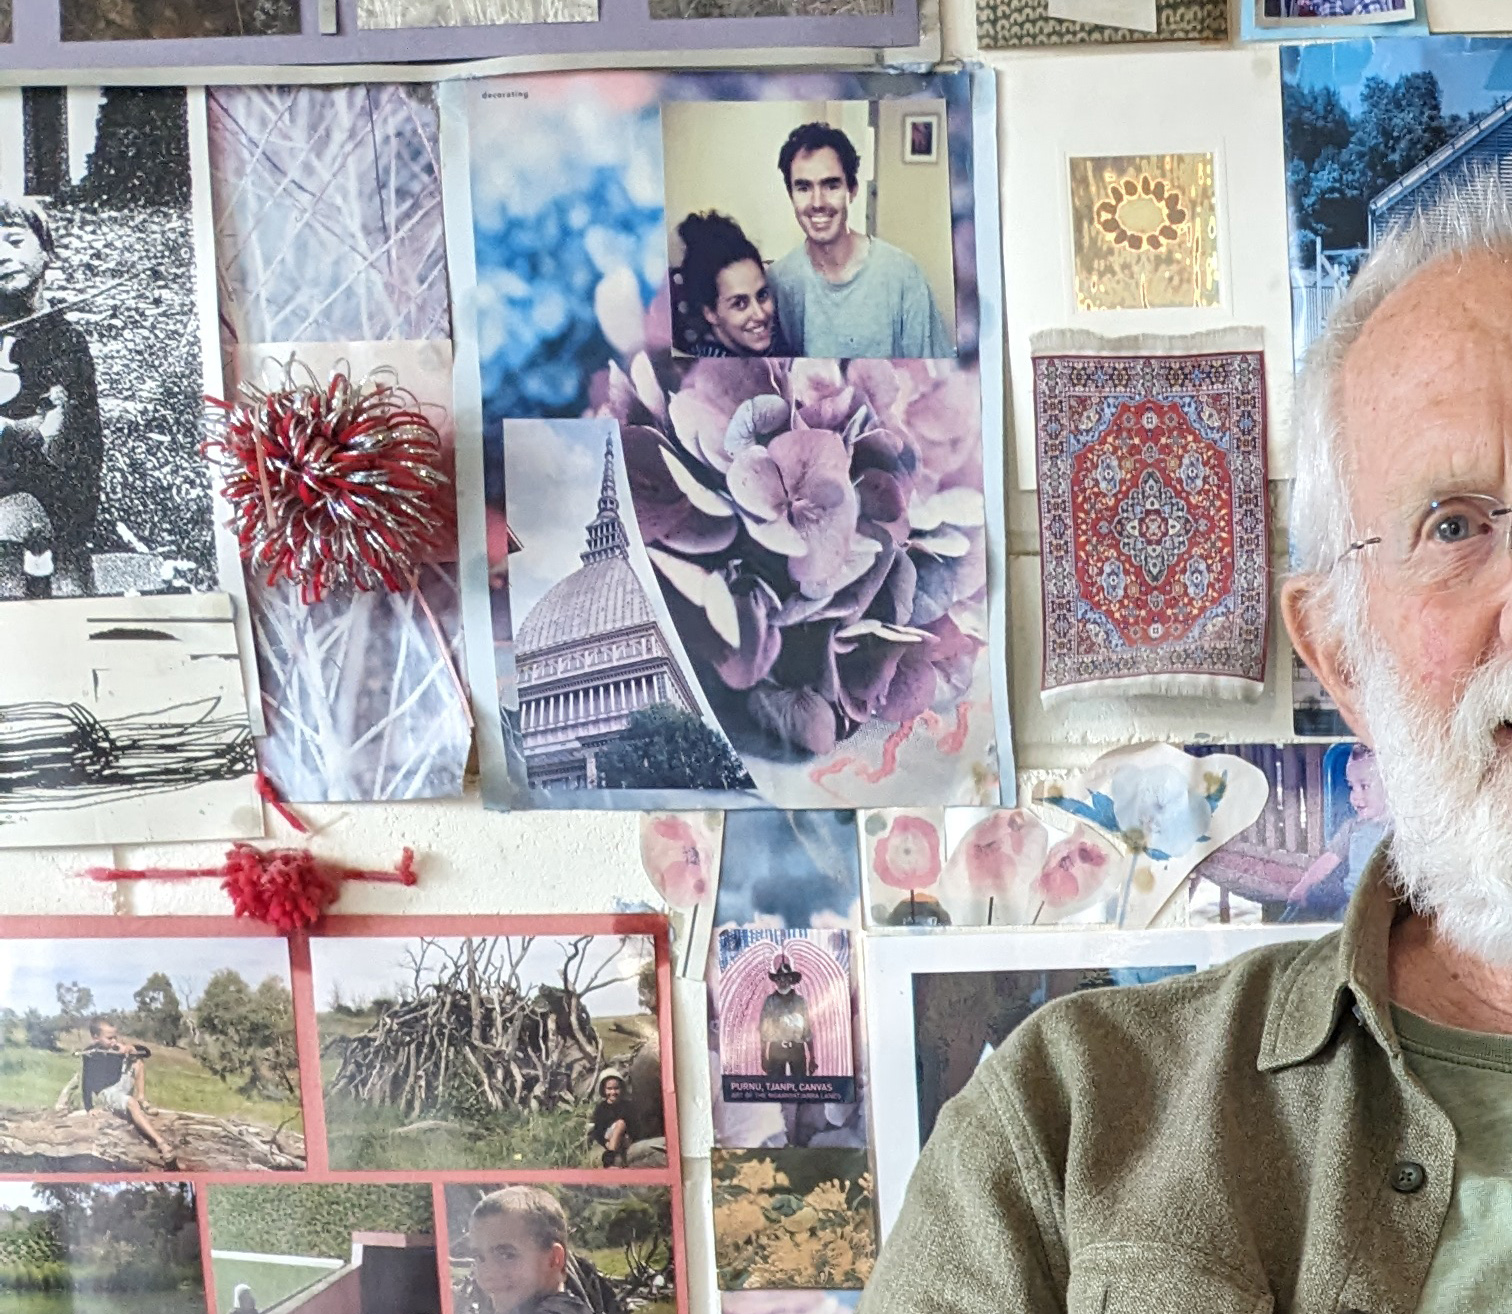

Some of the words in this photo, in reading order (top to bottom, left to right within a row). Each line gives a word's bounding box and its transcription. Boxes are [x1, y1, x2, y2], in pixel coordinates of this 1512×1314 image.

[481, 91, 529, 100] decorating
[730, 1082, 764, 1092] PURNU,
[766, 1082, 797, 1092] TJANPI,
[799, 1082, 833, 1092] CANVAS
